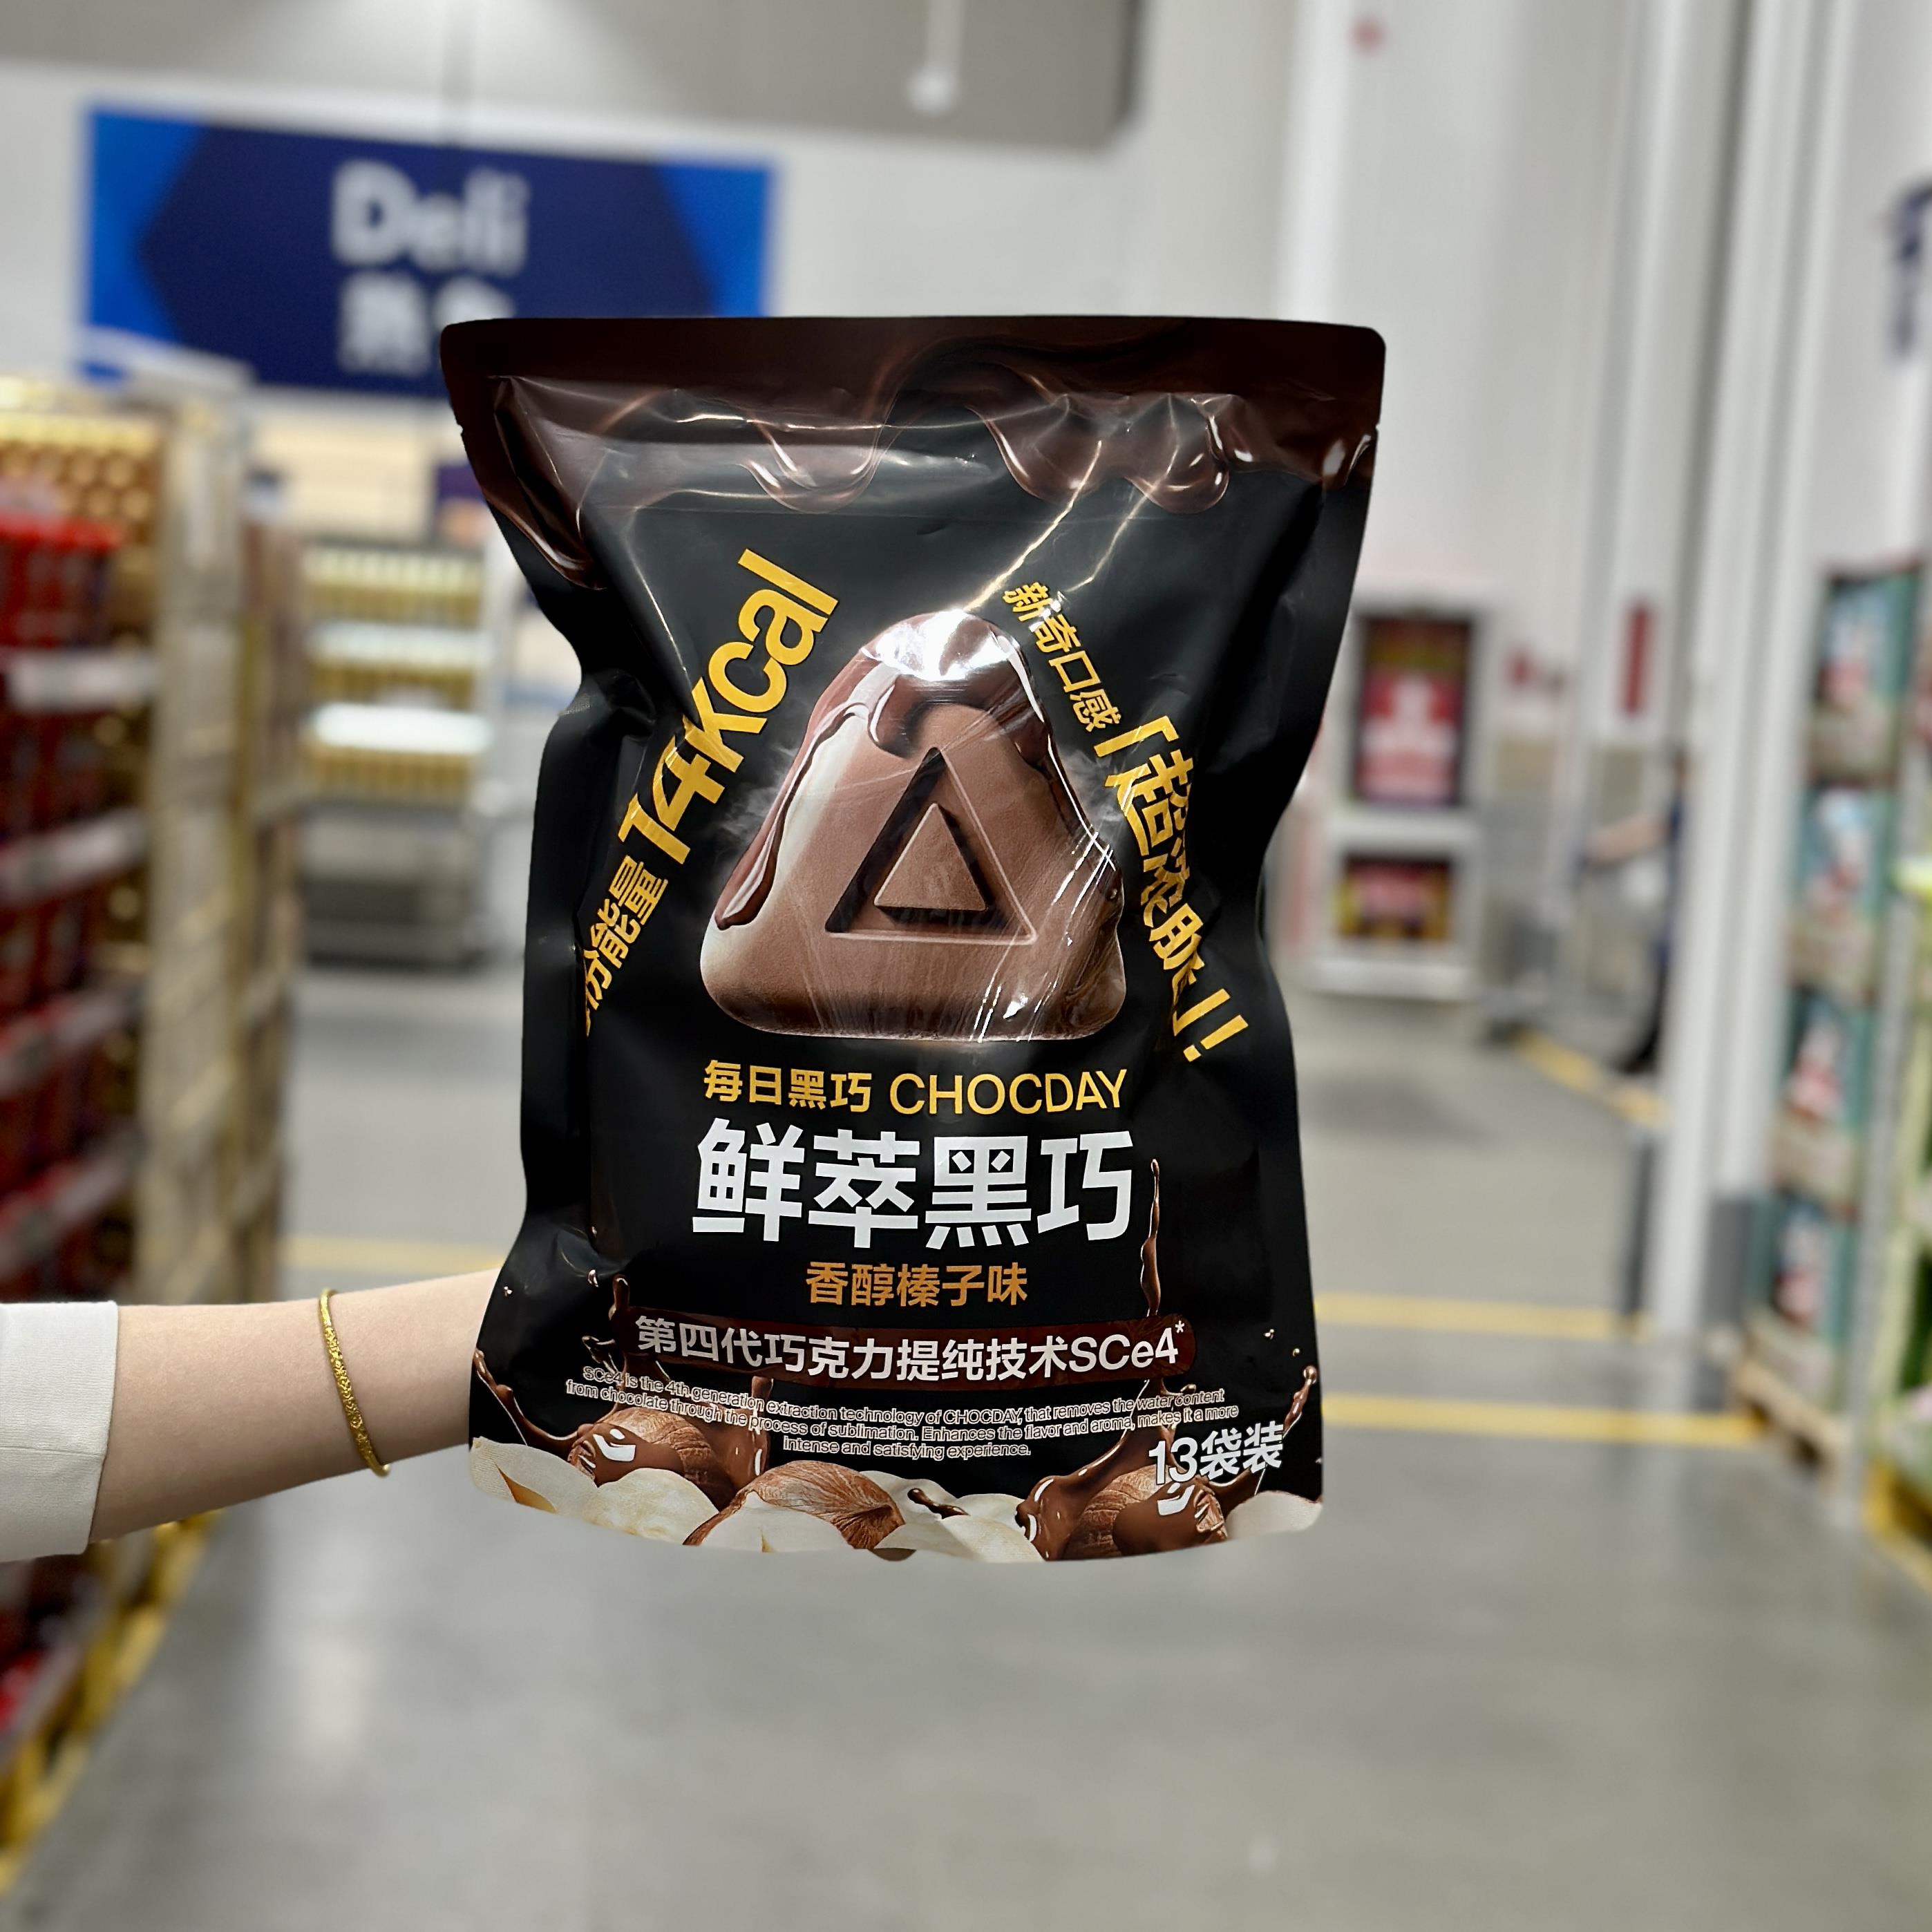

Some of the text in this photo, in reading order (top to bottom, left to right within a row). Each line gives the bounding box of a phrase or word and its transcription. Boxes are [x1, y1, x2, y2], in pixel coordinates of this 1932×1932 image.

[333, 159, 528, 278] Deli
[1003, 582, 1121, 732] 新奇口感
[583, 855, 669, 1036] 份能量
[703, 1059, 1128, 1115] 每日黑巧 CHOCDAY
[692, 1117, 1133, 1250] 鲜萃黑巧
[806, 1261, 1029, 1307] 香醇榛子味
[566, 1379, 1238, 1441] from chocolate through the process of sublimation. Enhances the flavor and aroma, makes it a more
[625, 1373, 638, 1388] is
[641, 1375, 663, 1392] the
[665, 1381, 690, 1396] 4th
[691, 1386, 764, 1411] generation
[766, 1400, 837, 1420] extraction
[840, 1407, 924, 1426] technology
[925, 1410, 942, 1424] of
[944, 1408, 1023, 1425] CHOCDAY,
[1024, 1405, 1051, 1422] that
[1052, 1401, 1110, 1419] removes
[1112, 1397, 1133, 1413] the
[1137, 1395, 1174, 1410] water
[1175, 1388, 1225, 1406] content
[841, 1441, 871, 1456] and
[873, 1443, 945, 1461] satisfying
[947, 1442, 1031, 1460] experience.
[1148, 1420, 1284, 1485] 13袋装
